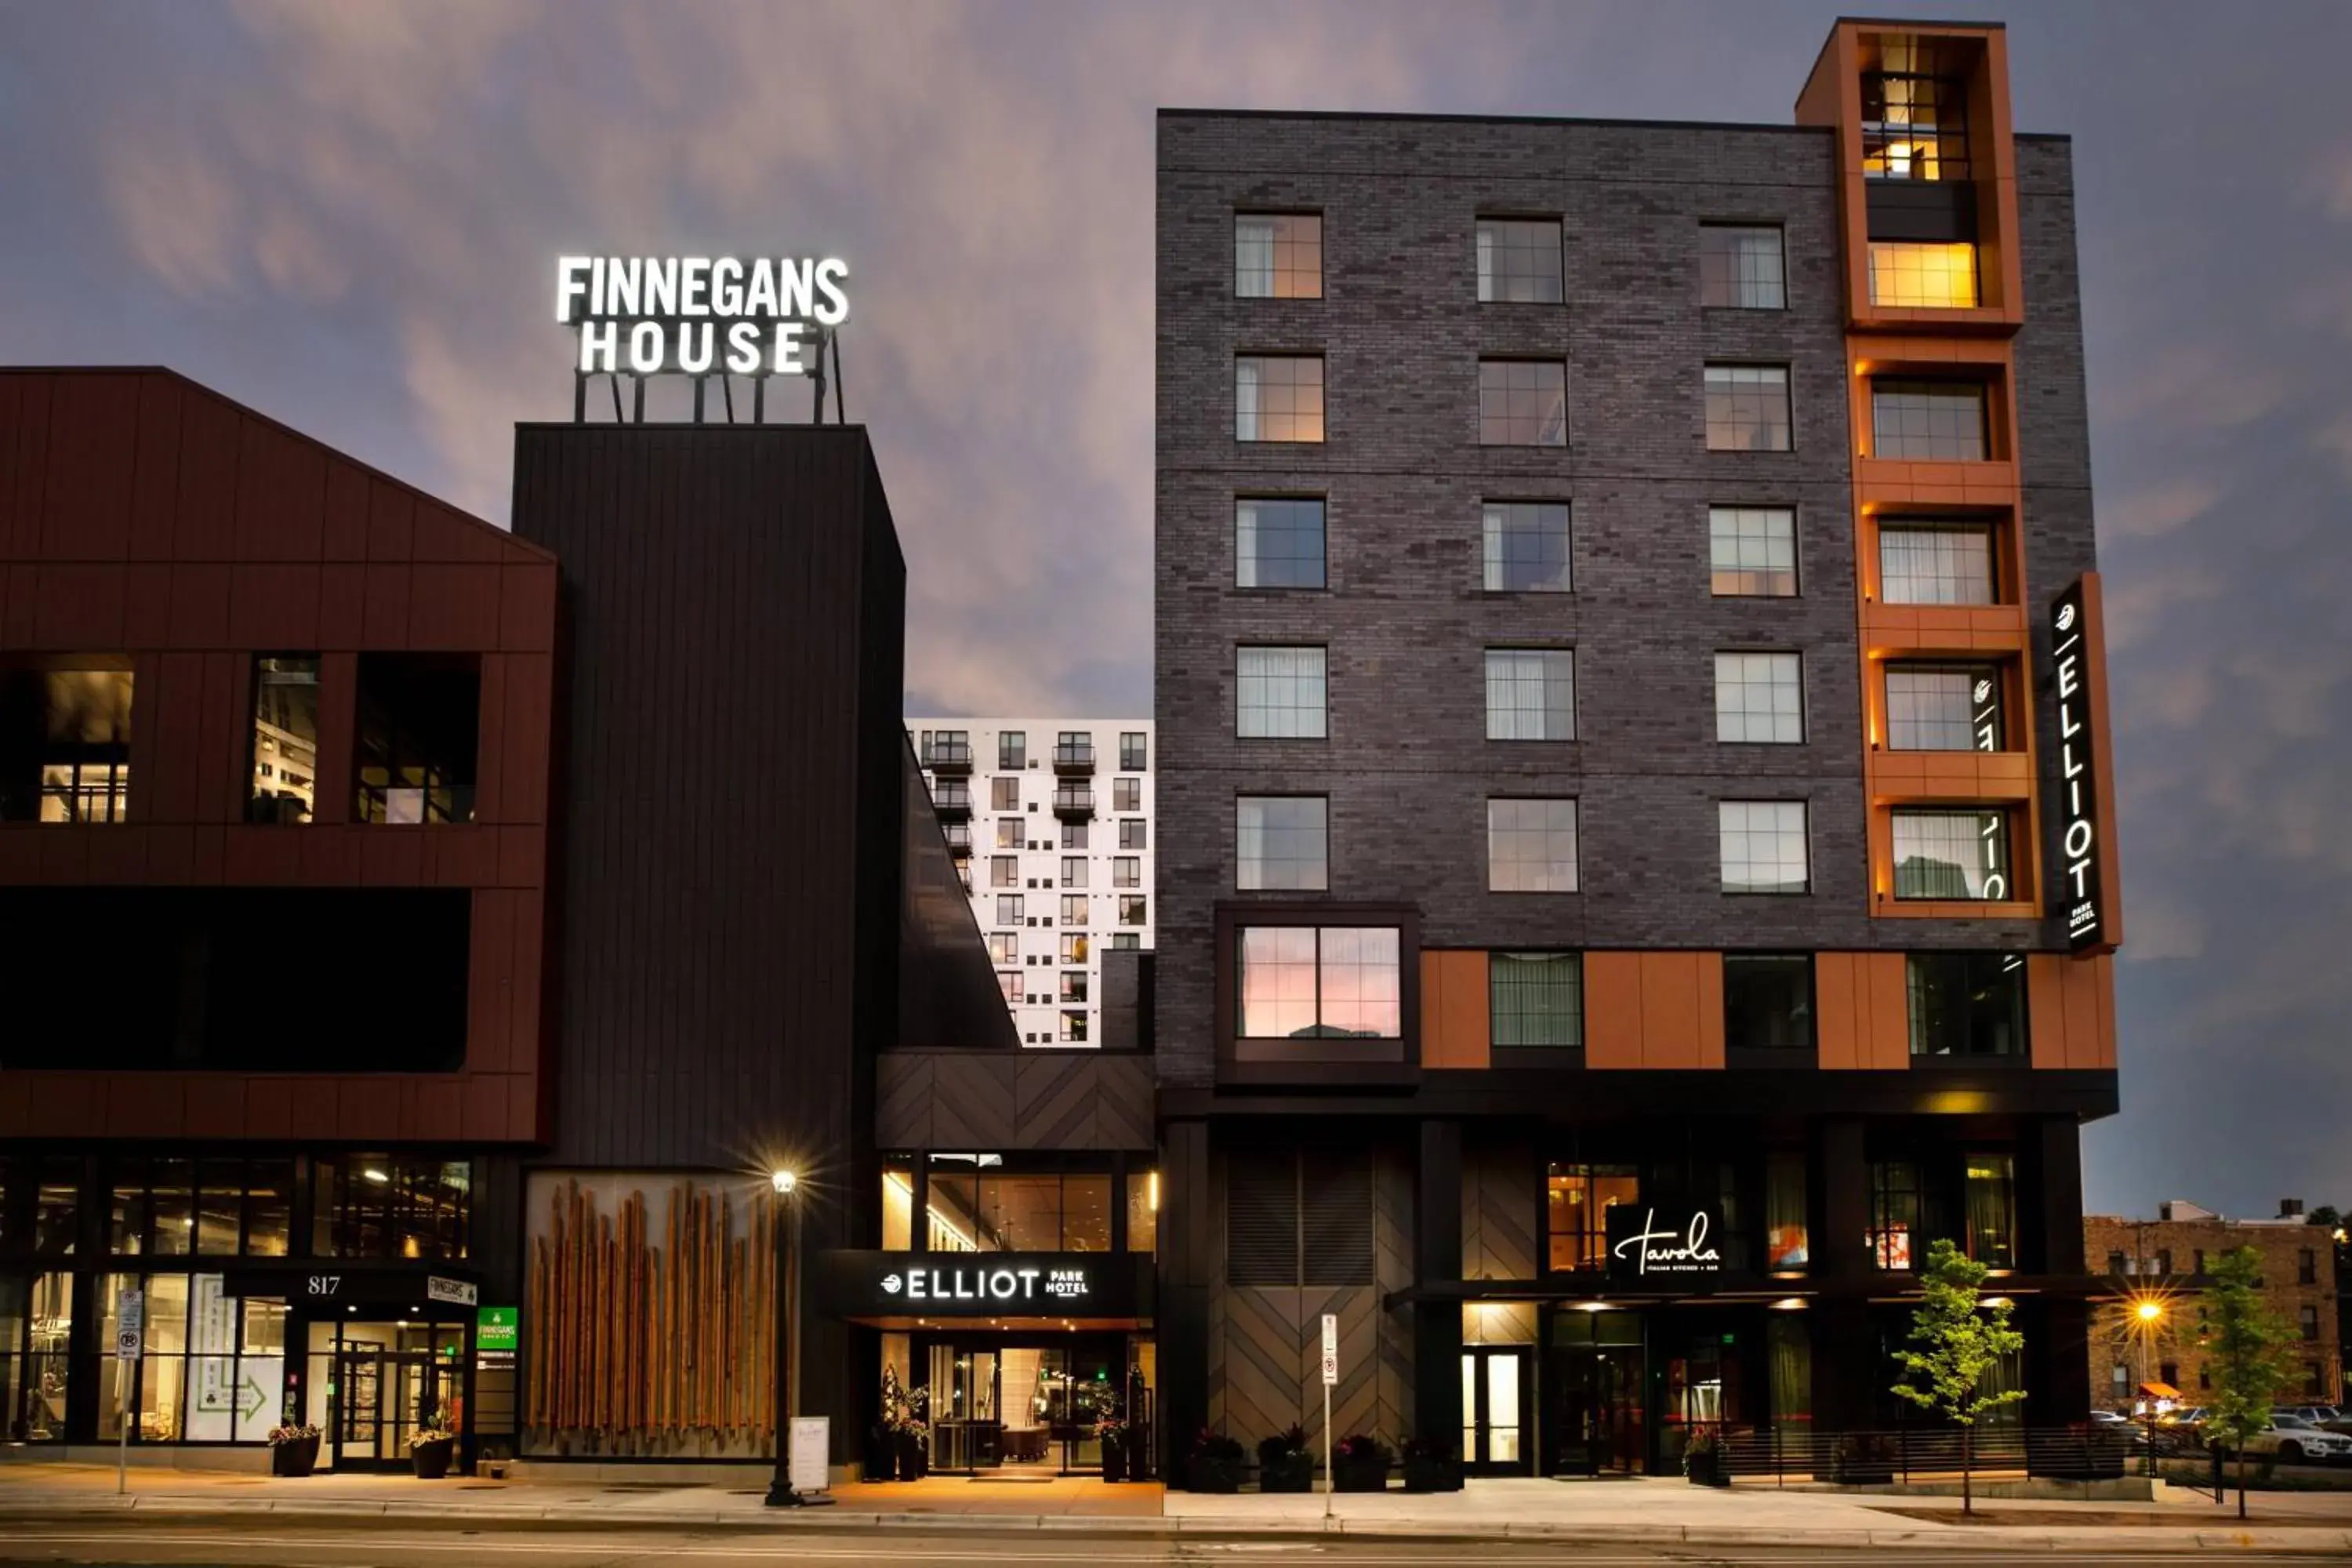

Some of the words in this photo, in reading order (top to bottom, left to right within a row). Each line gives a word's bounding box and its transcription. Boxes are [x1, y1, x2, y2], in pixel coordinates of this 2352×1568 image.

[557, 257, 849, 325] FINNEGANS
[580, 321, 804, 372] HOUSE
[2059, 655, 2092, 898] ELLIOT
[2070, 909, 2096, 927] HOTEL
[308, 1276, 340, 1294] 817
[907, 1269, 1040, 1299] ELLIOT
[1045, 1282, 1089, 1293] HOTEL
[1051, 1270, 1083, 1282] PARK
